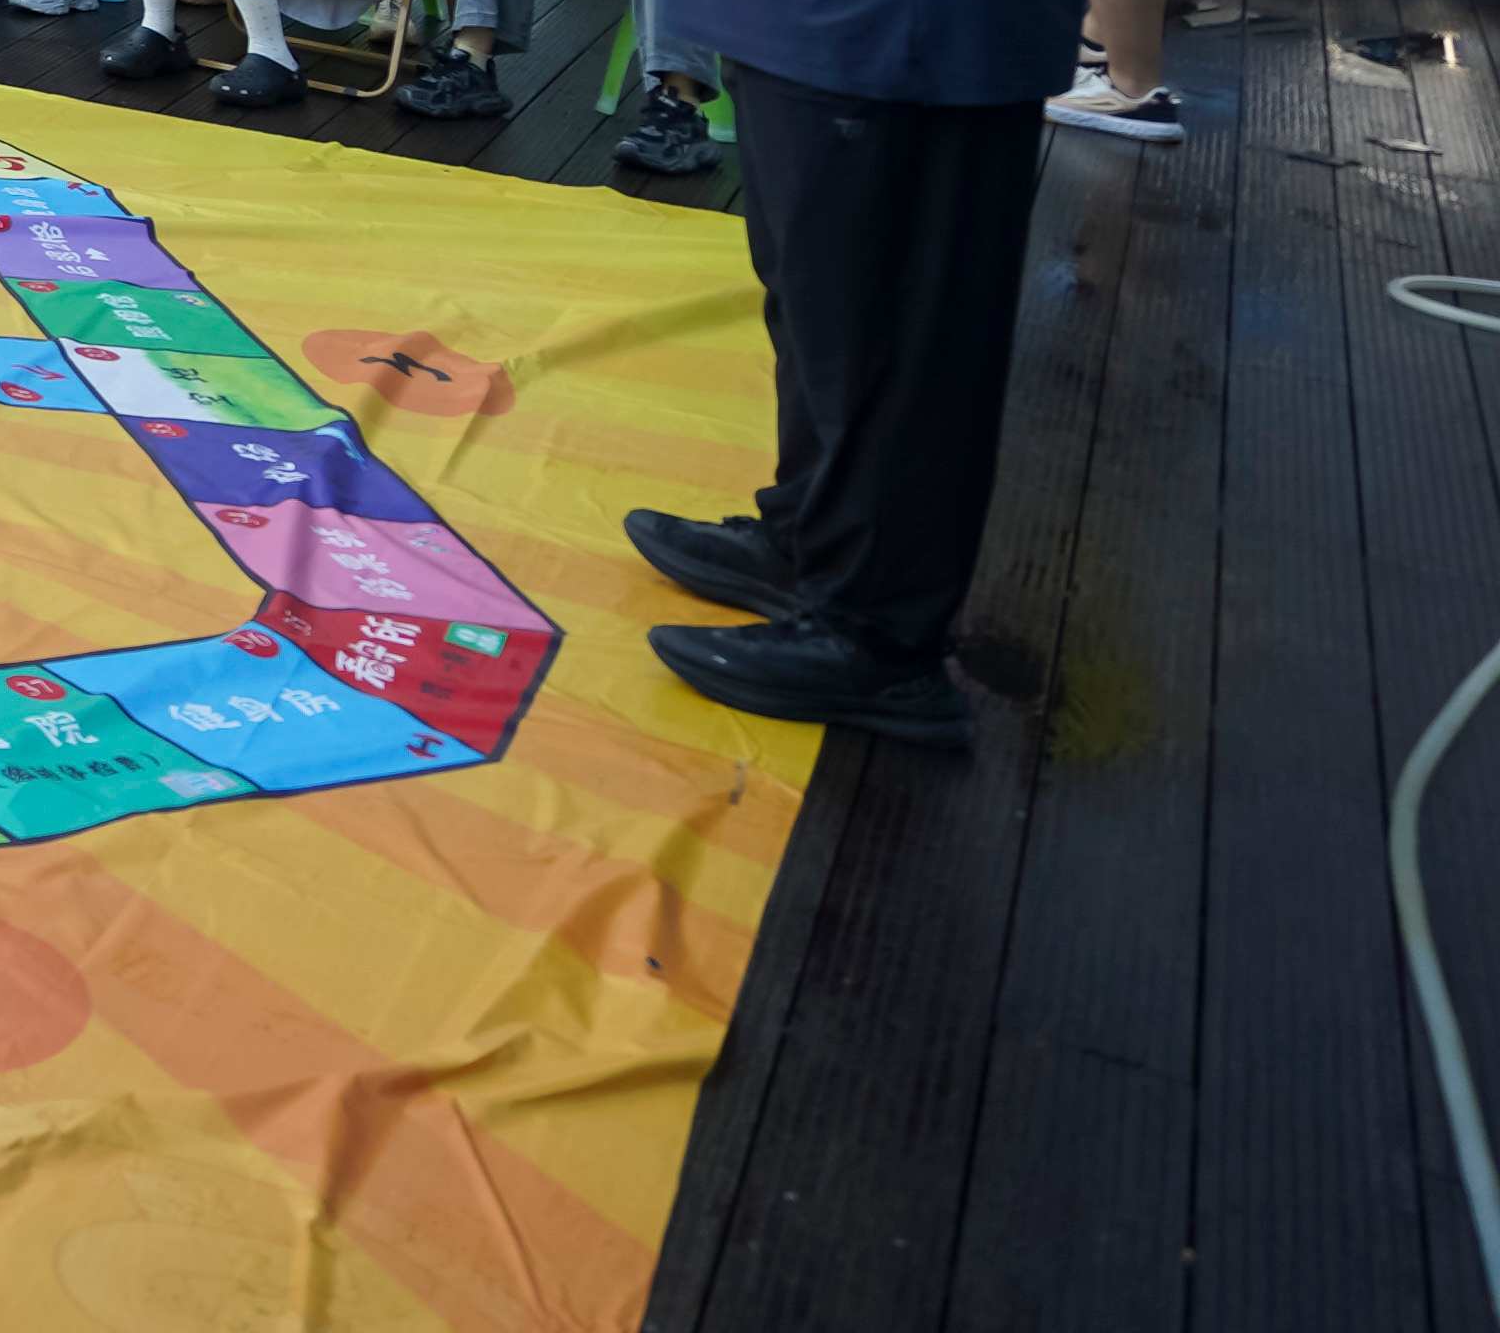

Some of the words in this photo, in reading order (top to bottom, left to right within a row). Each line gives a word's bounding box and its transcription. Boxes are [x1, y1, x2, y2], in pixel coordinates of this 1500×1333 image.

[231, 442, 311, 484] 机场
[310, 525, 413, 601] 彩票站
[335, 614, 423, 690] 看守所
[26, 677, 55, 697] 37
[169, 686, 342, 734] 健身房
